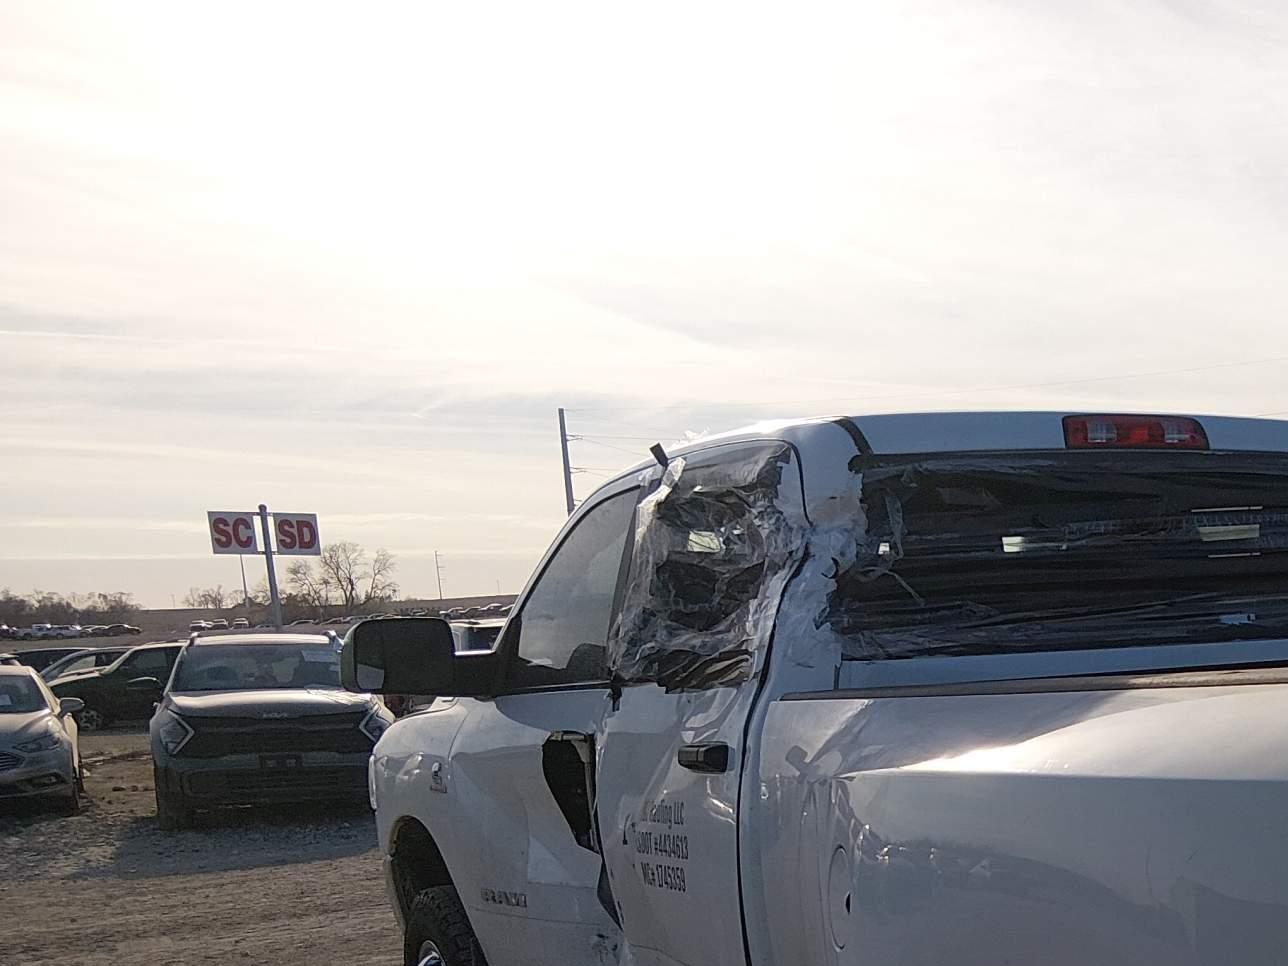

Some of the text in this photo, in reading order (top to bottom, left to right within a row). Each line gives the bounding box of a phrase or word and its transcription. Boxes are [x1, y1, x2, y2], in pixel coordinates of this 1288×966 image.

[212, 517, 254, 549] SC
[277, 518, 318, 550] SD
[673, 801, 685, 825] LLC
